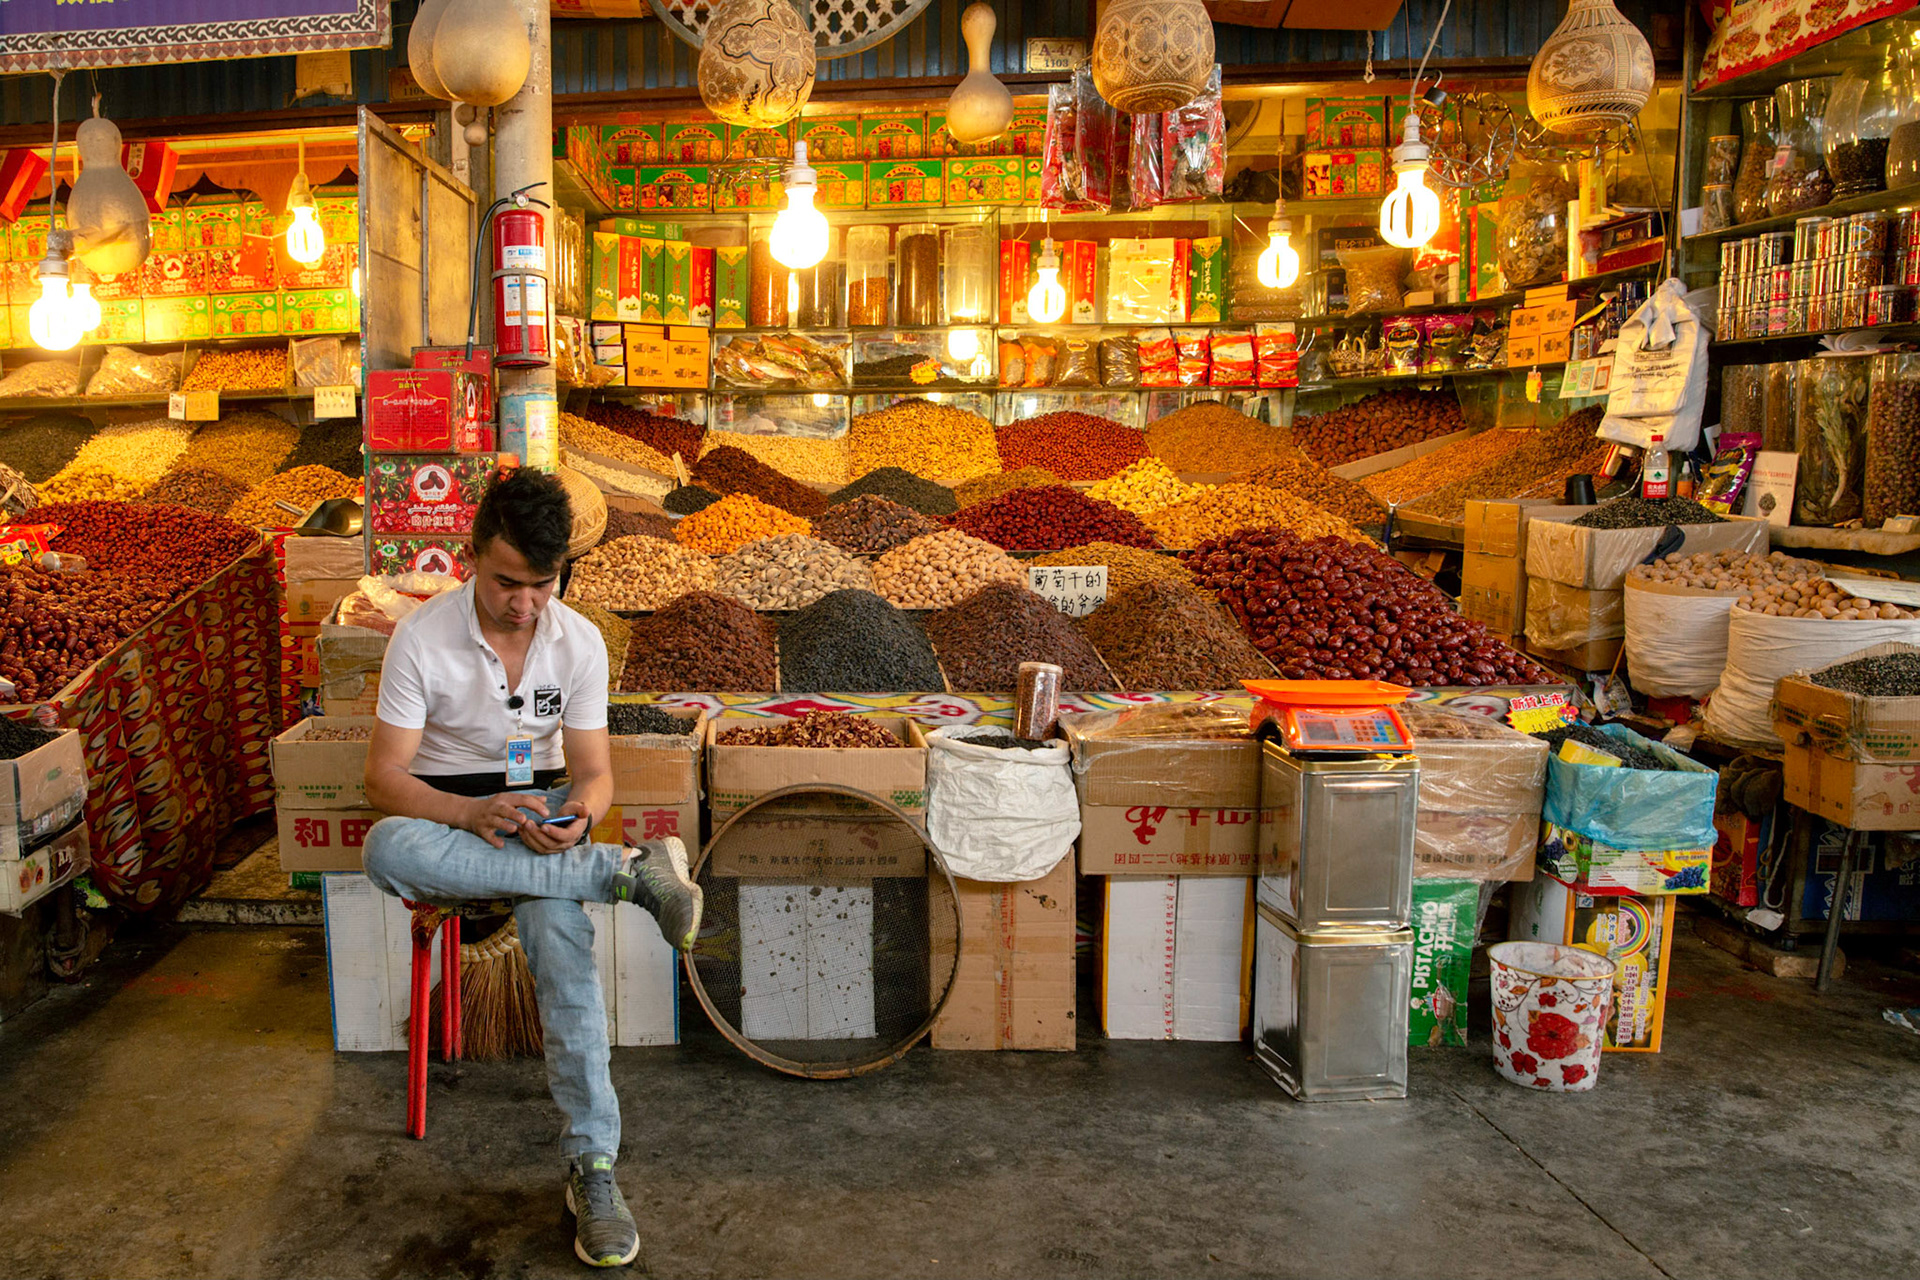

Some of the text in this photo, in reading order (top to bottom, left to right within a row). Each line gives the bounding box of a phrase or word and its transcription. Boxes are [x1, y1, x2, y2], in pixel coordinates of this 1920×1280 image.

[1039, 43, 1074, 56] A-47
[1045, 59, 1069, 68] 1103
[1034, 569, 1101, 591] 葡萄干的
[294, 818, 374, 848] 和田
[1413, 901, 1438, 989] PISTACHIO
